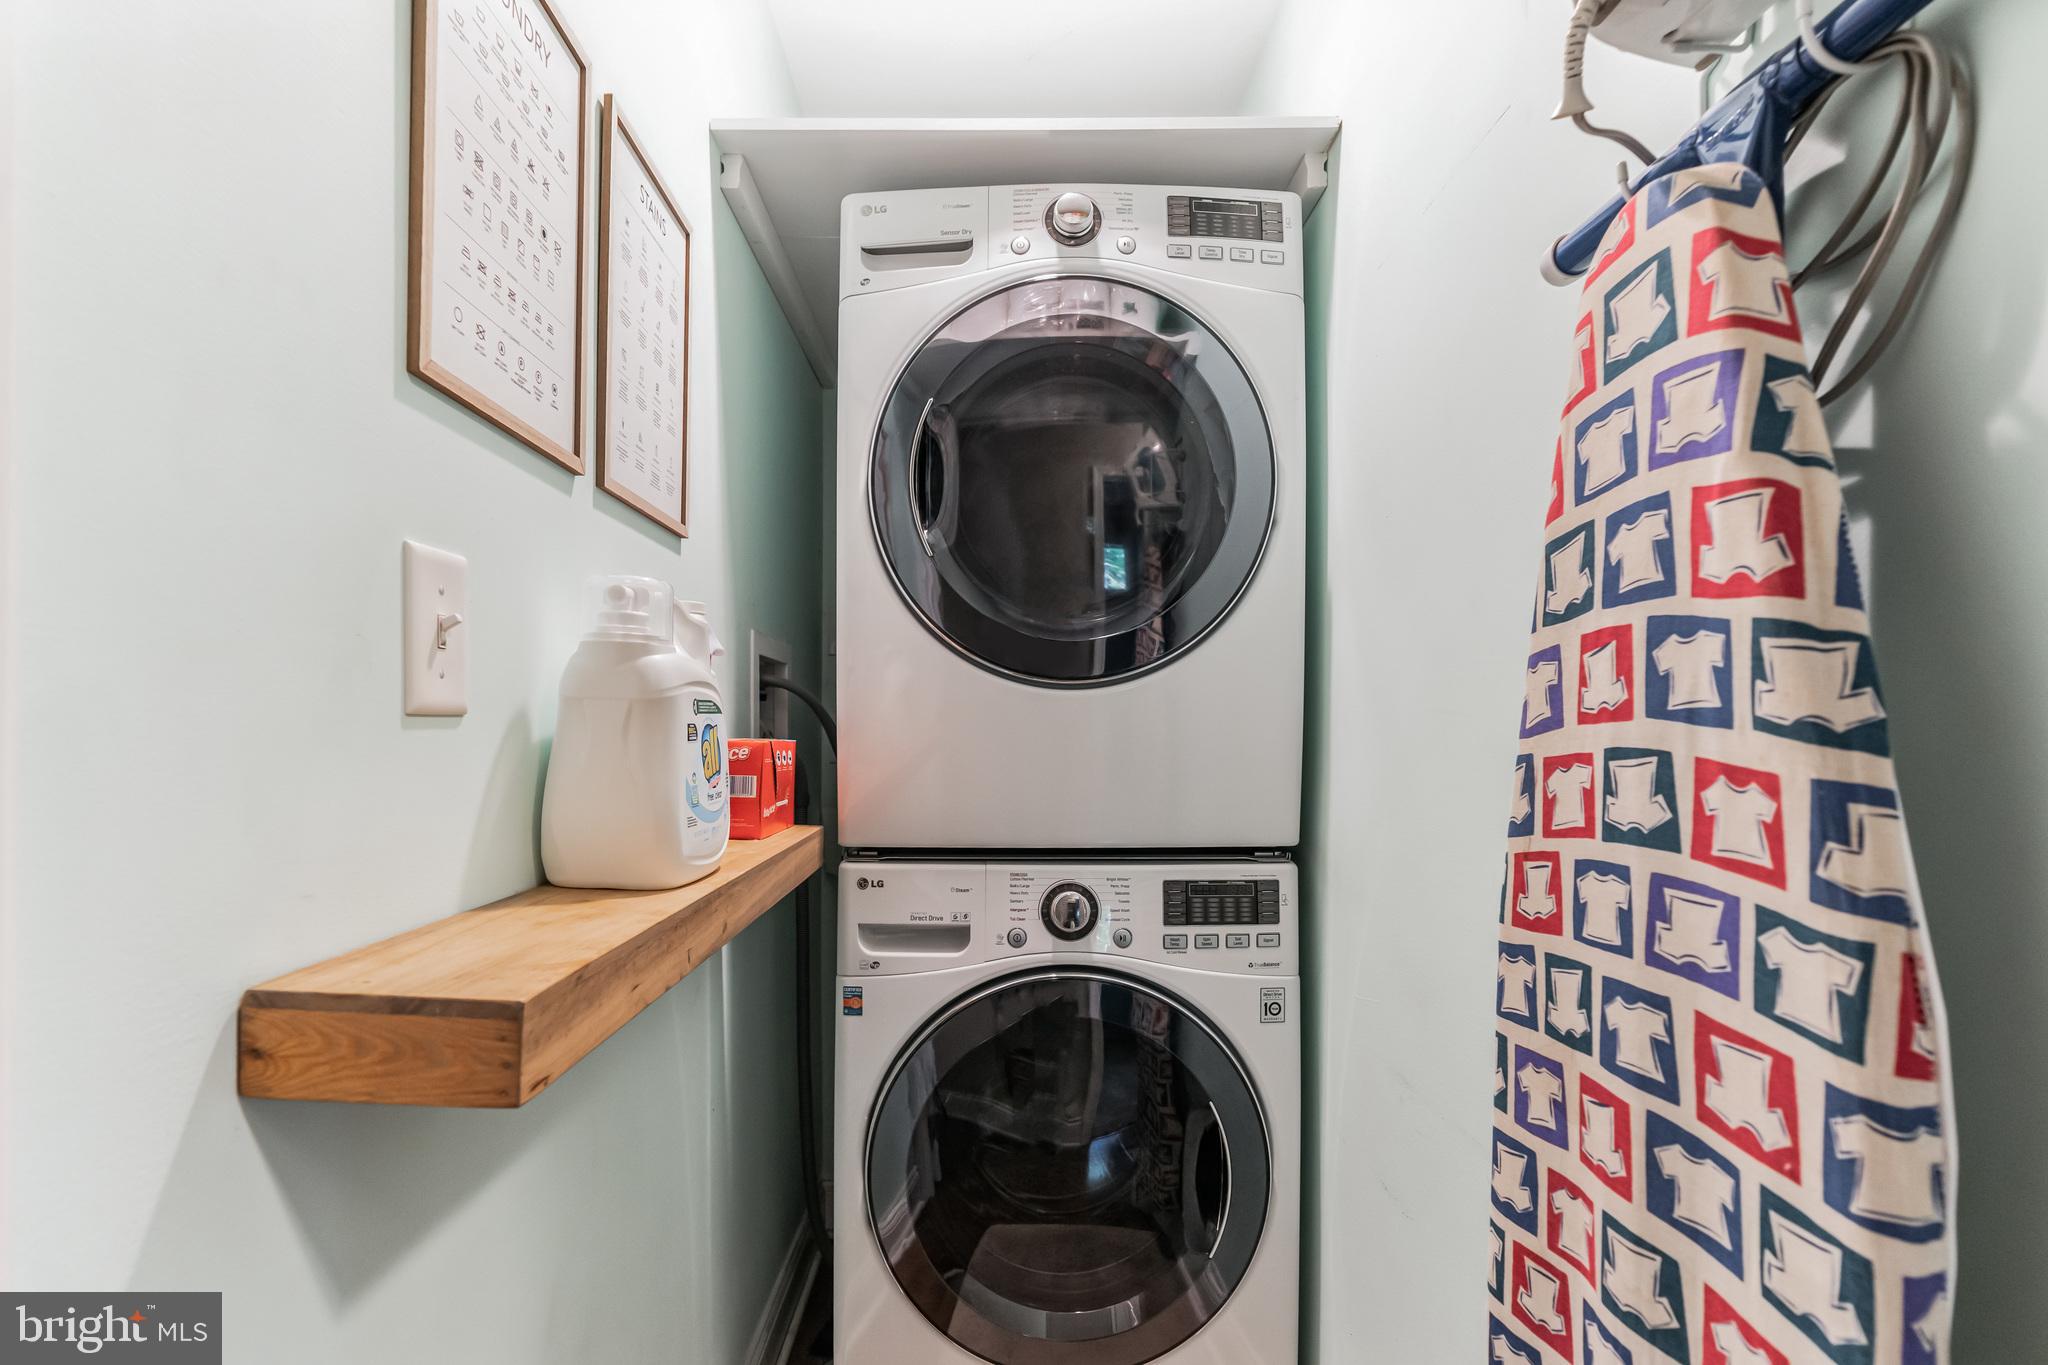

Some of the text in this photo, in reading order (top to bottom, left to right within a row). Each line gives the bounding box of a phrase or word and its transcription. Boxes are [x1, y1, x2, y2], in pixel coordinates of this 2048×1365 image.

[639, 184, 667, 237] STAINS
[702, 725, 720, 781] all
[910, 914, 944, 922] Direct Drive
[1263, 1001, 1282, 1017] 10
